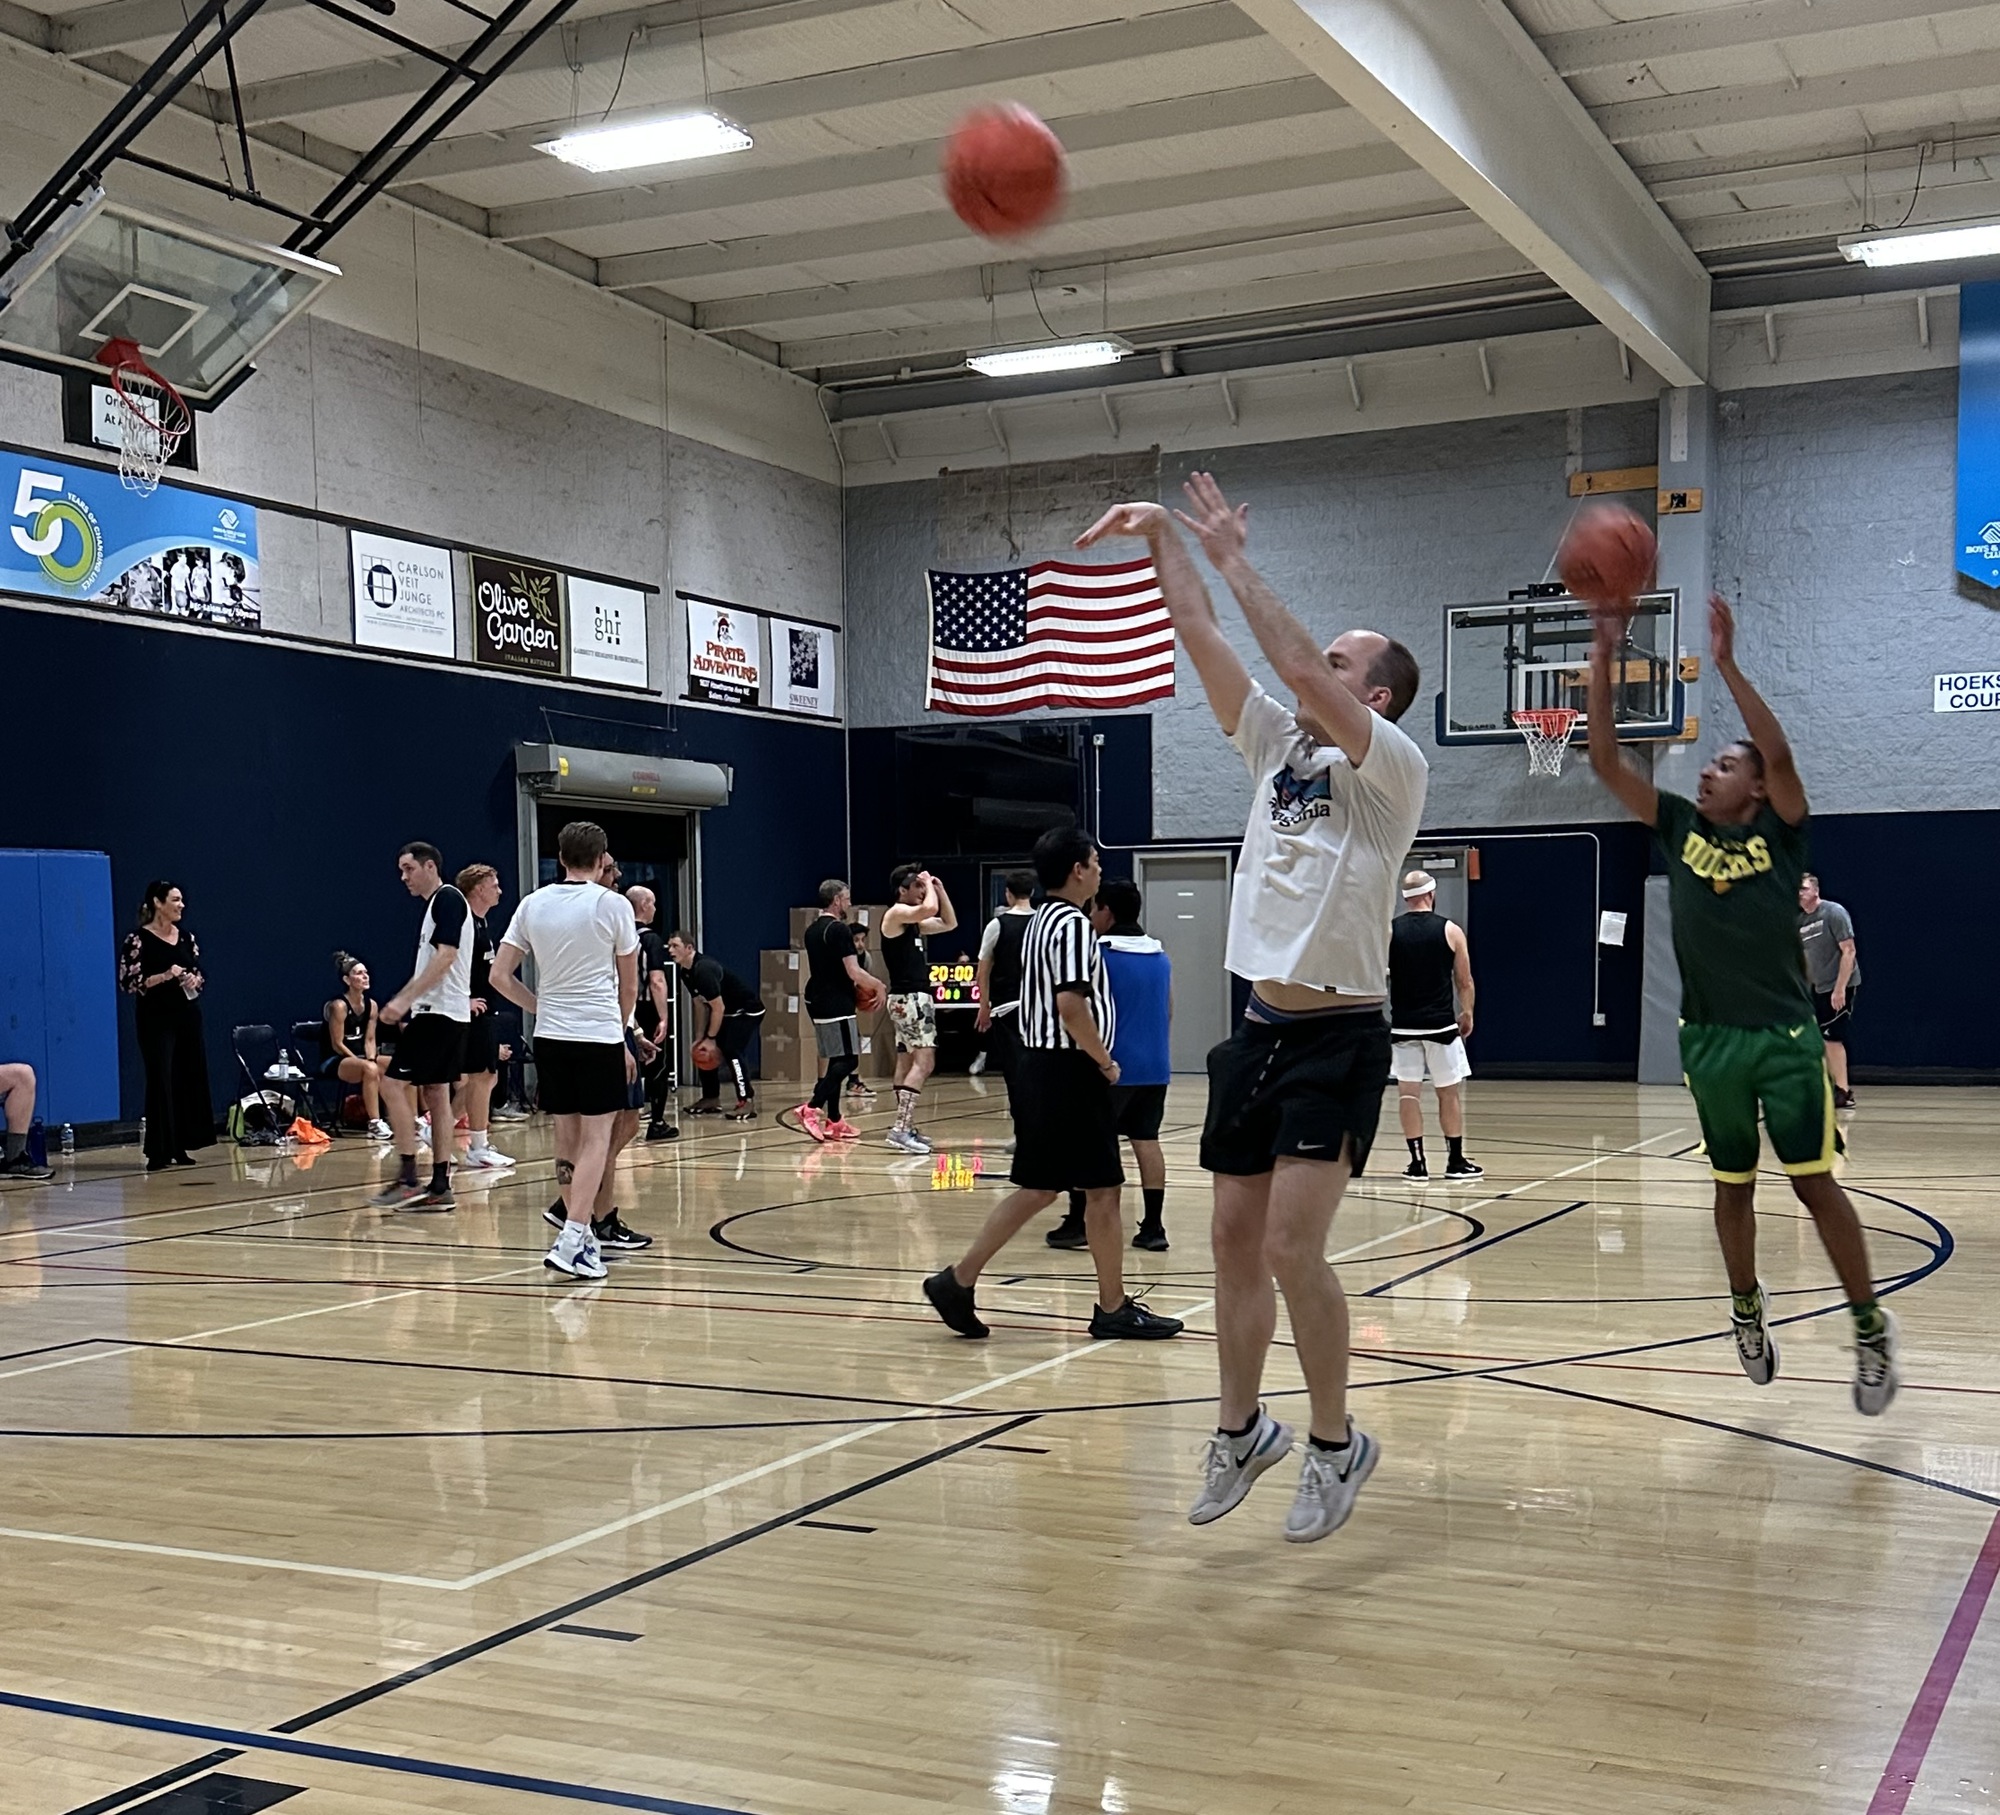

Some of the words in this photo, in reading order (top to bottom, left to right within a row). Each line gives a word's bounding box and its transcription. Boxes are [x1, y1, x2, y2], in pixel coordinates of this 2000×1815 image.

[104, 412, 116, 426] At
[67, 492, 89, 517] YEARS
[87, 511, 98, 525] OF
[10, 467, 98, 587] 50
[1965, 544, 1990, 554] BOYS
[397, 561, 445, 580] CARLSON
[398, 575, 419, 590] VEIT
[399, 590, 432, 606] JUNGE
[478, 581, 530, 618] Olive
[486, 611, 559, 652] Garden
[594, 609, 622, 641] ghr
[504, 653, 529, 665] ITALIAN
[705, 640, 746, 663] PIRATE
[693, 654, 758, 684] ADVENTURE
[789, 693, 819, 706] SWEENEY
[1681, 830, 1773, 880] DUCKS
[929, 965, 974, 982] 20:00
